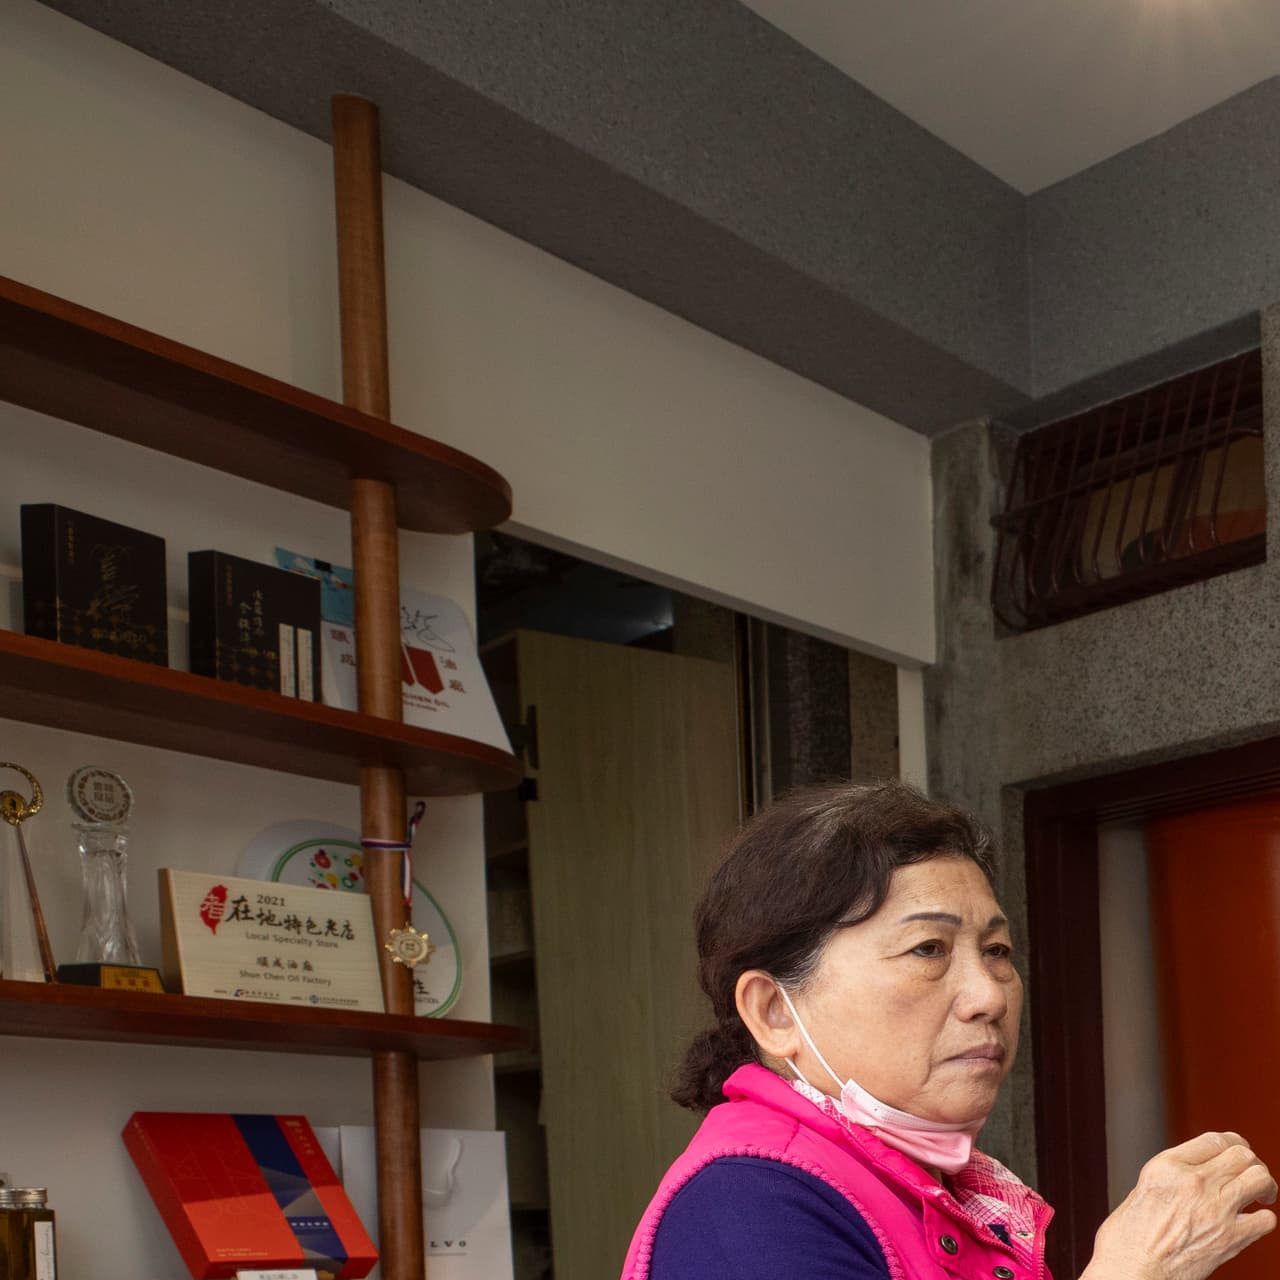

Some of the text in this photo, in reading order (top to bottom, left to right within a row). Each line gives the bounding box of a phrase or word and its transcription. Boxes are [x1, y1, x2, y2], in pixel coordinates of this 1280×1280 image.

[256, 894, 286, 907] 2021
[225, 895, 355, 940] 在地特色老店
[246, 931, 339, 948] Local Specialty Store
[264, 971, 285, 981] Chen
[302, 975, 332, 986] Factory
